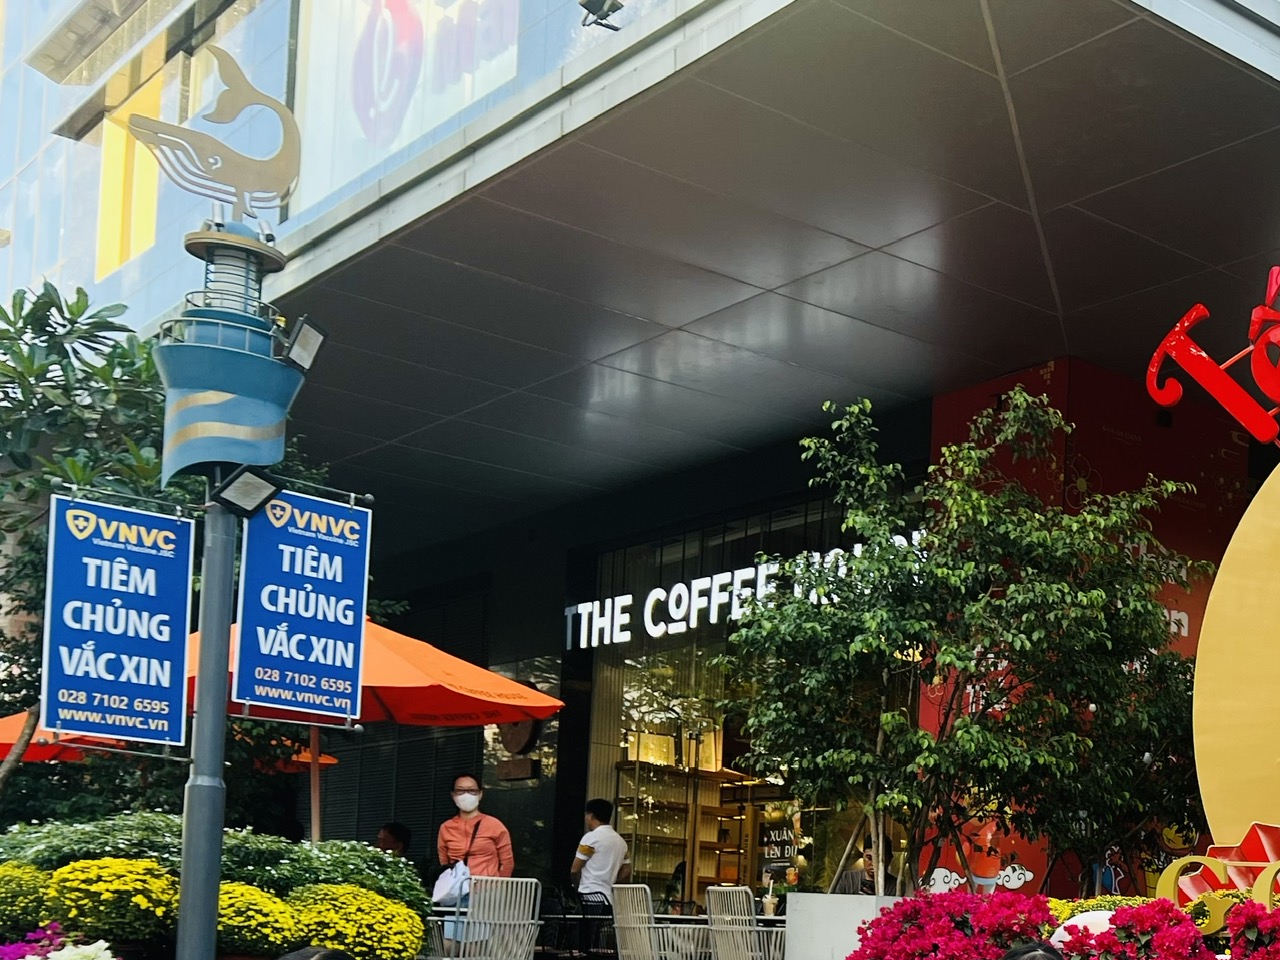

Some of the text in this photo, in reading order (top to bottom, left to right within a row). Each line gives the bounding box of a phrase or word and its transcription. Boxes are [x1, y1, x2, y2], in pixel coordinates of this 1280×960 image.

[97, 518, 176, 550] VNVC
[292, 508, 360, 540] VNVC
[82, 557, 157, 596] TIÊM
[278, 544, 343, 583] TIÊM
[62, 598, 170, 642] CHỦNG
[260, 583, 354, 626] CHỦNG
[577, 594, 633, 648] THE
[58, 640, 171, 688] VẮC XIN
[256, 622, 355, 669] VẮC XIN
[254, 667, 352, 694] 028 7102 6595
[254, 685, 351, 709] www.vnvc.vn
[58, 689, 169, 714] 028 7102 6595
[58, 708, 169, 731] www.vnvc.vn
